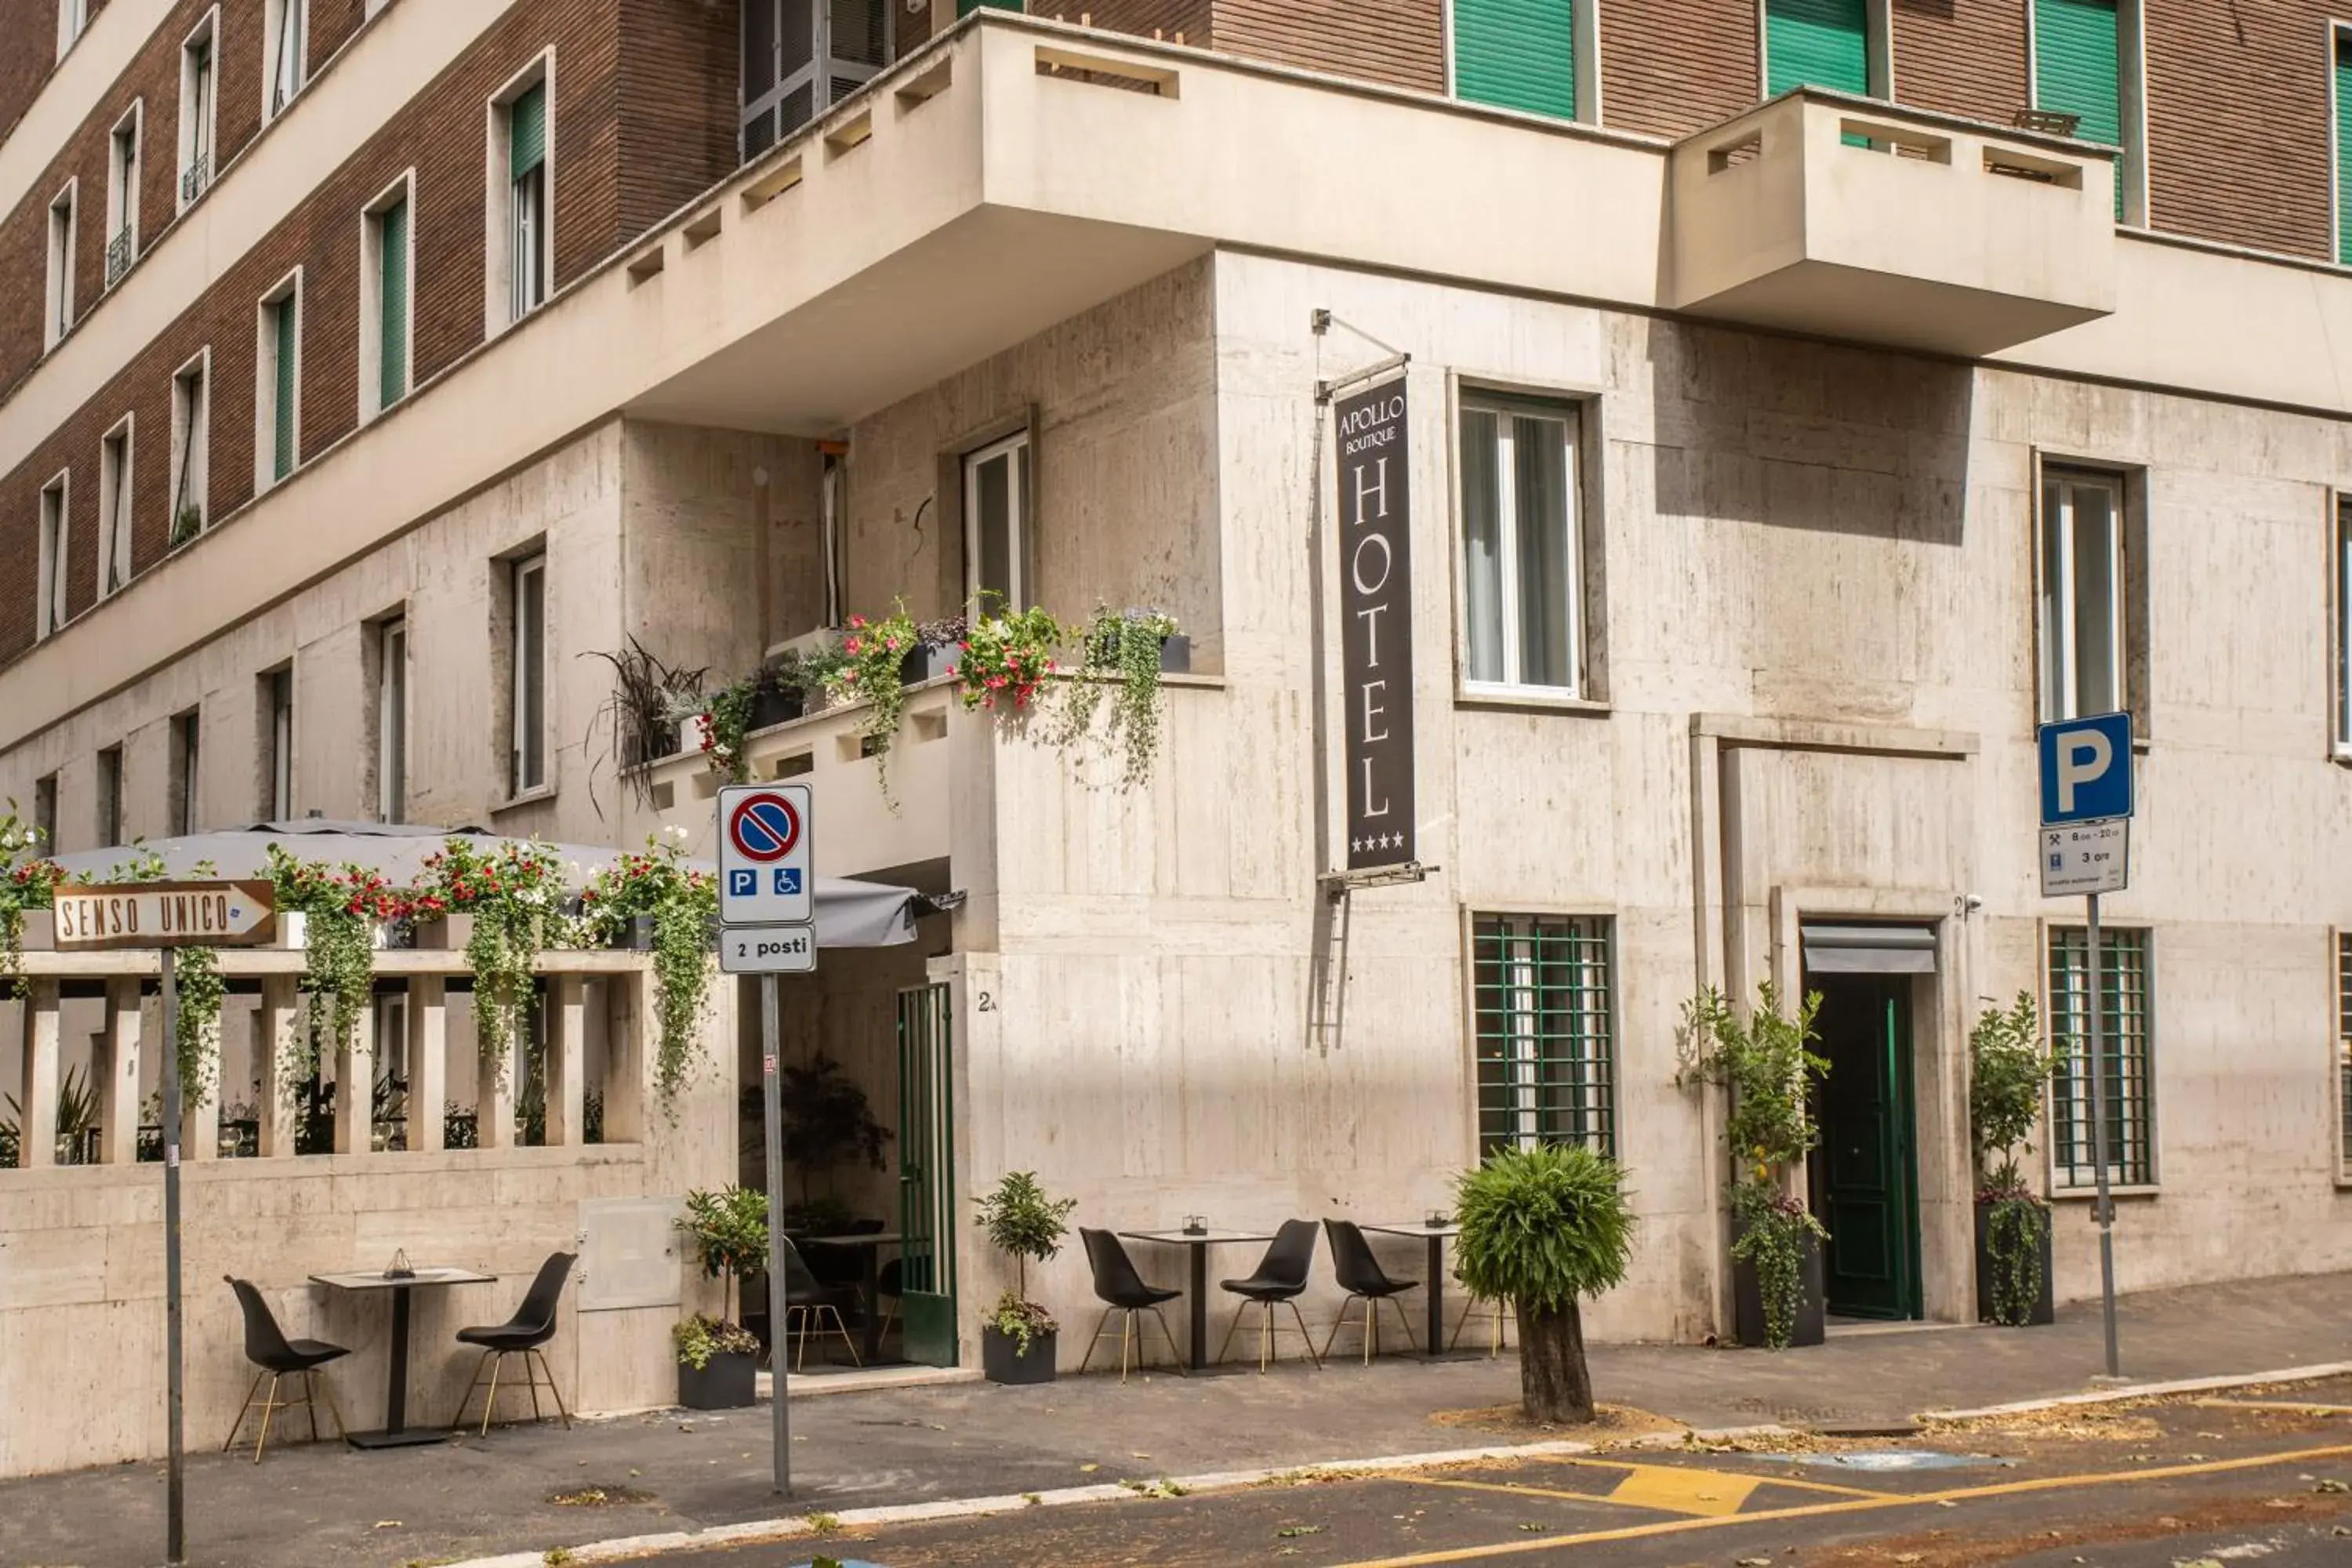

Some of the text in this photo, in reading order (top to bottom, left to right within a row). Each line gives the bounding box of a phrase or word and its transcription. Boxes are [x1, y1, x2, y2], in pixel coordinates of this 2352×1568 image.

[1340, 396, 1404, 437] APOLLO
[1346, 426, 1396, 455] BOUTIQUE
[1353, 458, 1392, 818] HOTEL
[2057, 729, 2112, 813] P
[2082, 852, 2089, 862] 3
[735, 873, 751, 893] P
[63, 895, 227, 936] SENSO UNICO
[1955, 896, 1962, 916] 2
[739, 938, 807, 957] 2 posti
